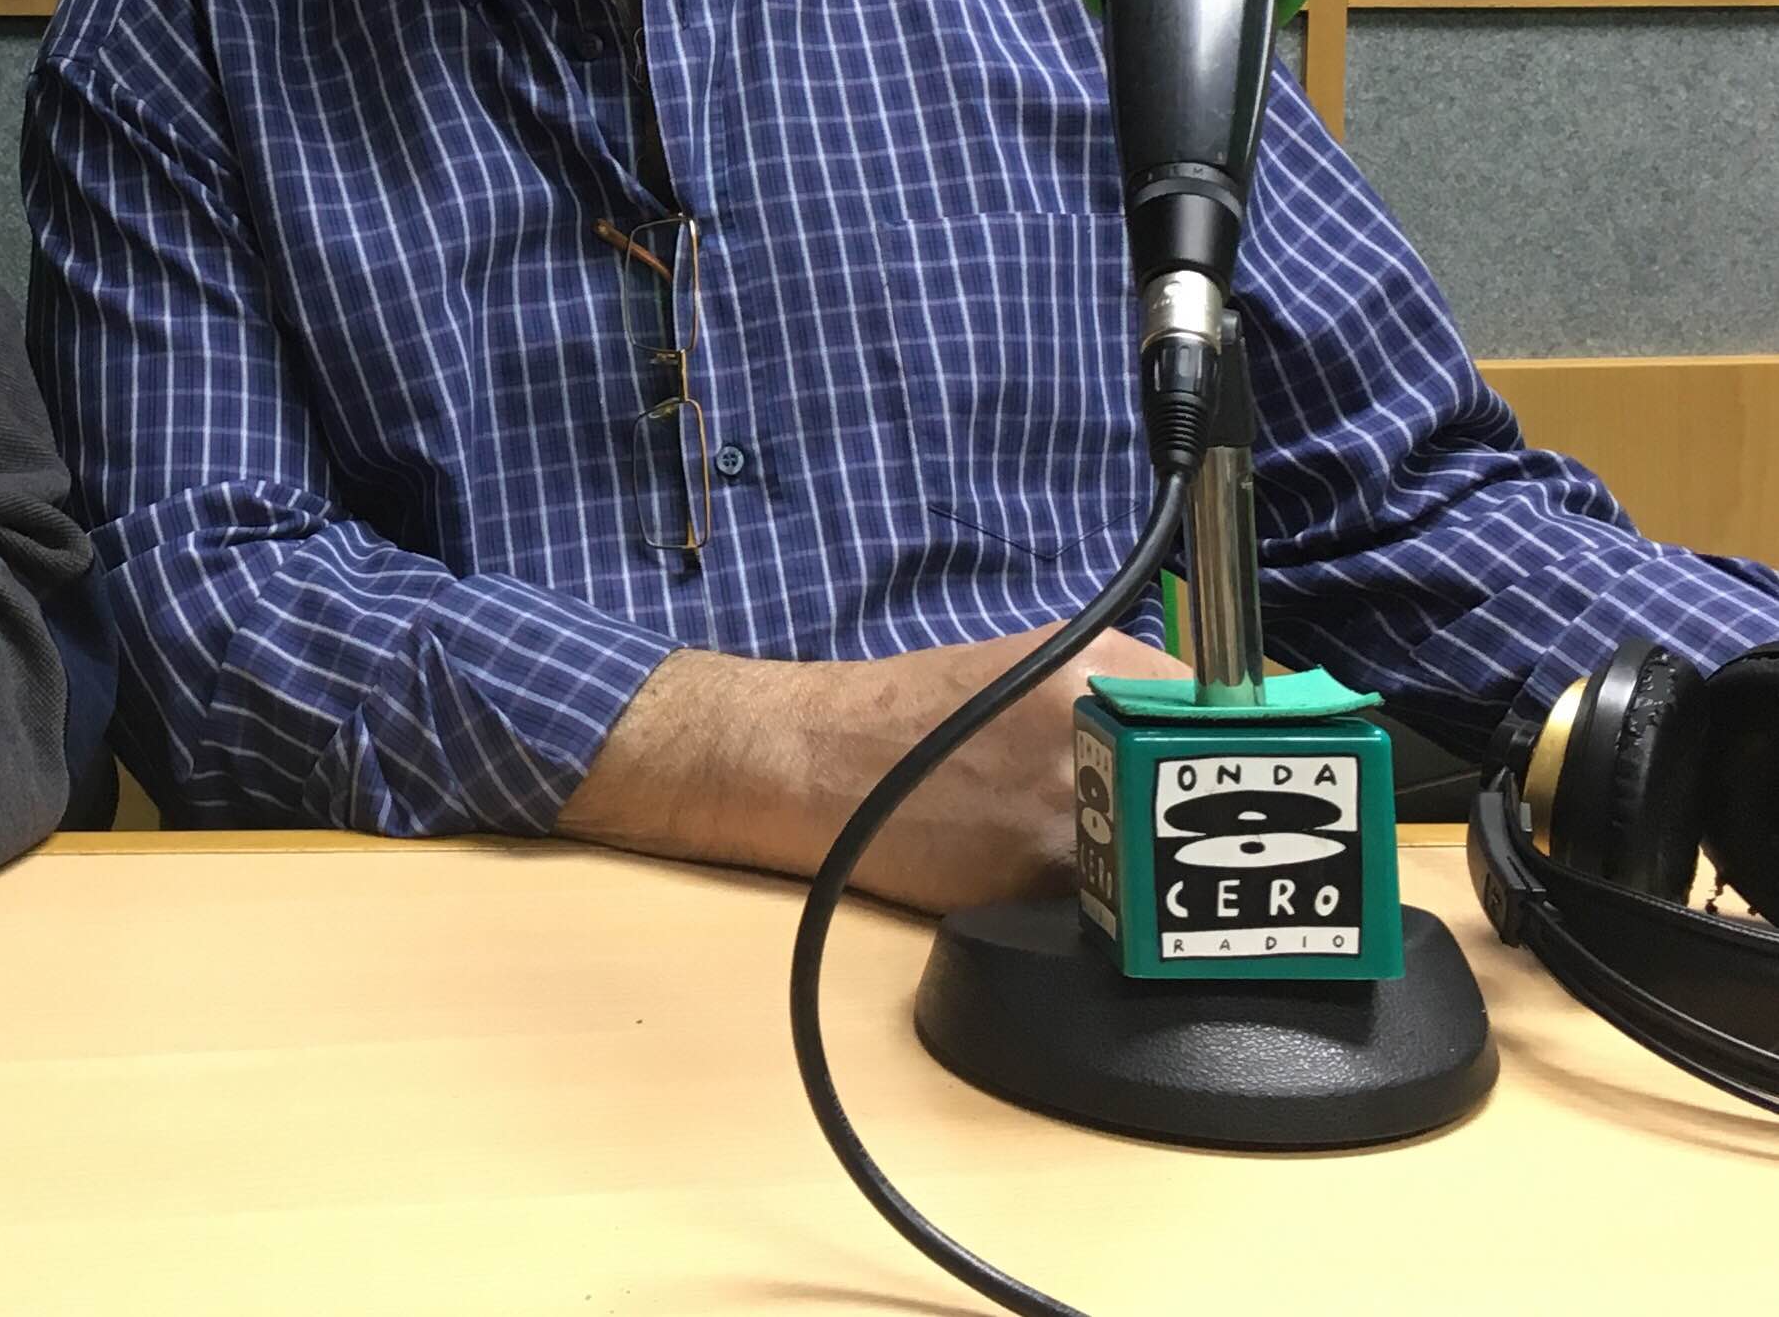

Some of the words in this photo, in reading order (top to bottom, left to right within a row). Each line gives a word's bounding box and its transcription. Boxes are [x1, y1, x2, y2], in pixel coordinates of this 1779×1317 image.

[1176, 763, 1338, 791] ONDA
[1165, 878, 1340, 919] CERO
[1172, 934, 1345, 953] RADIO
